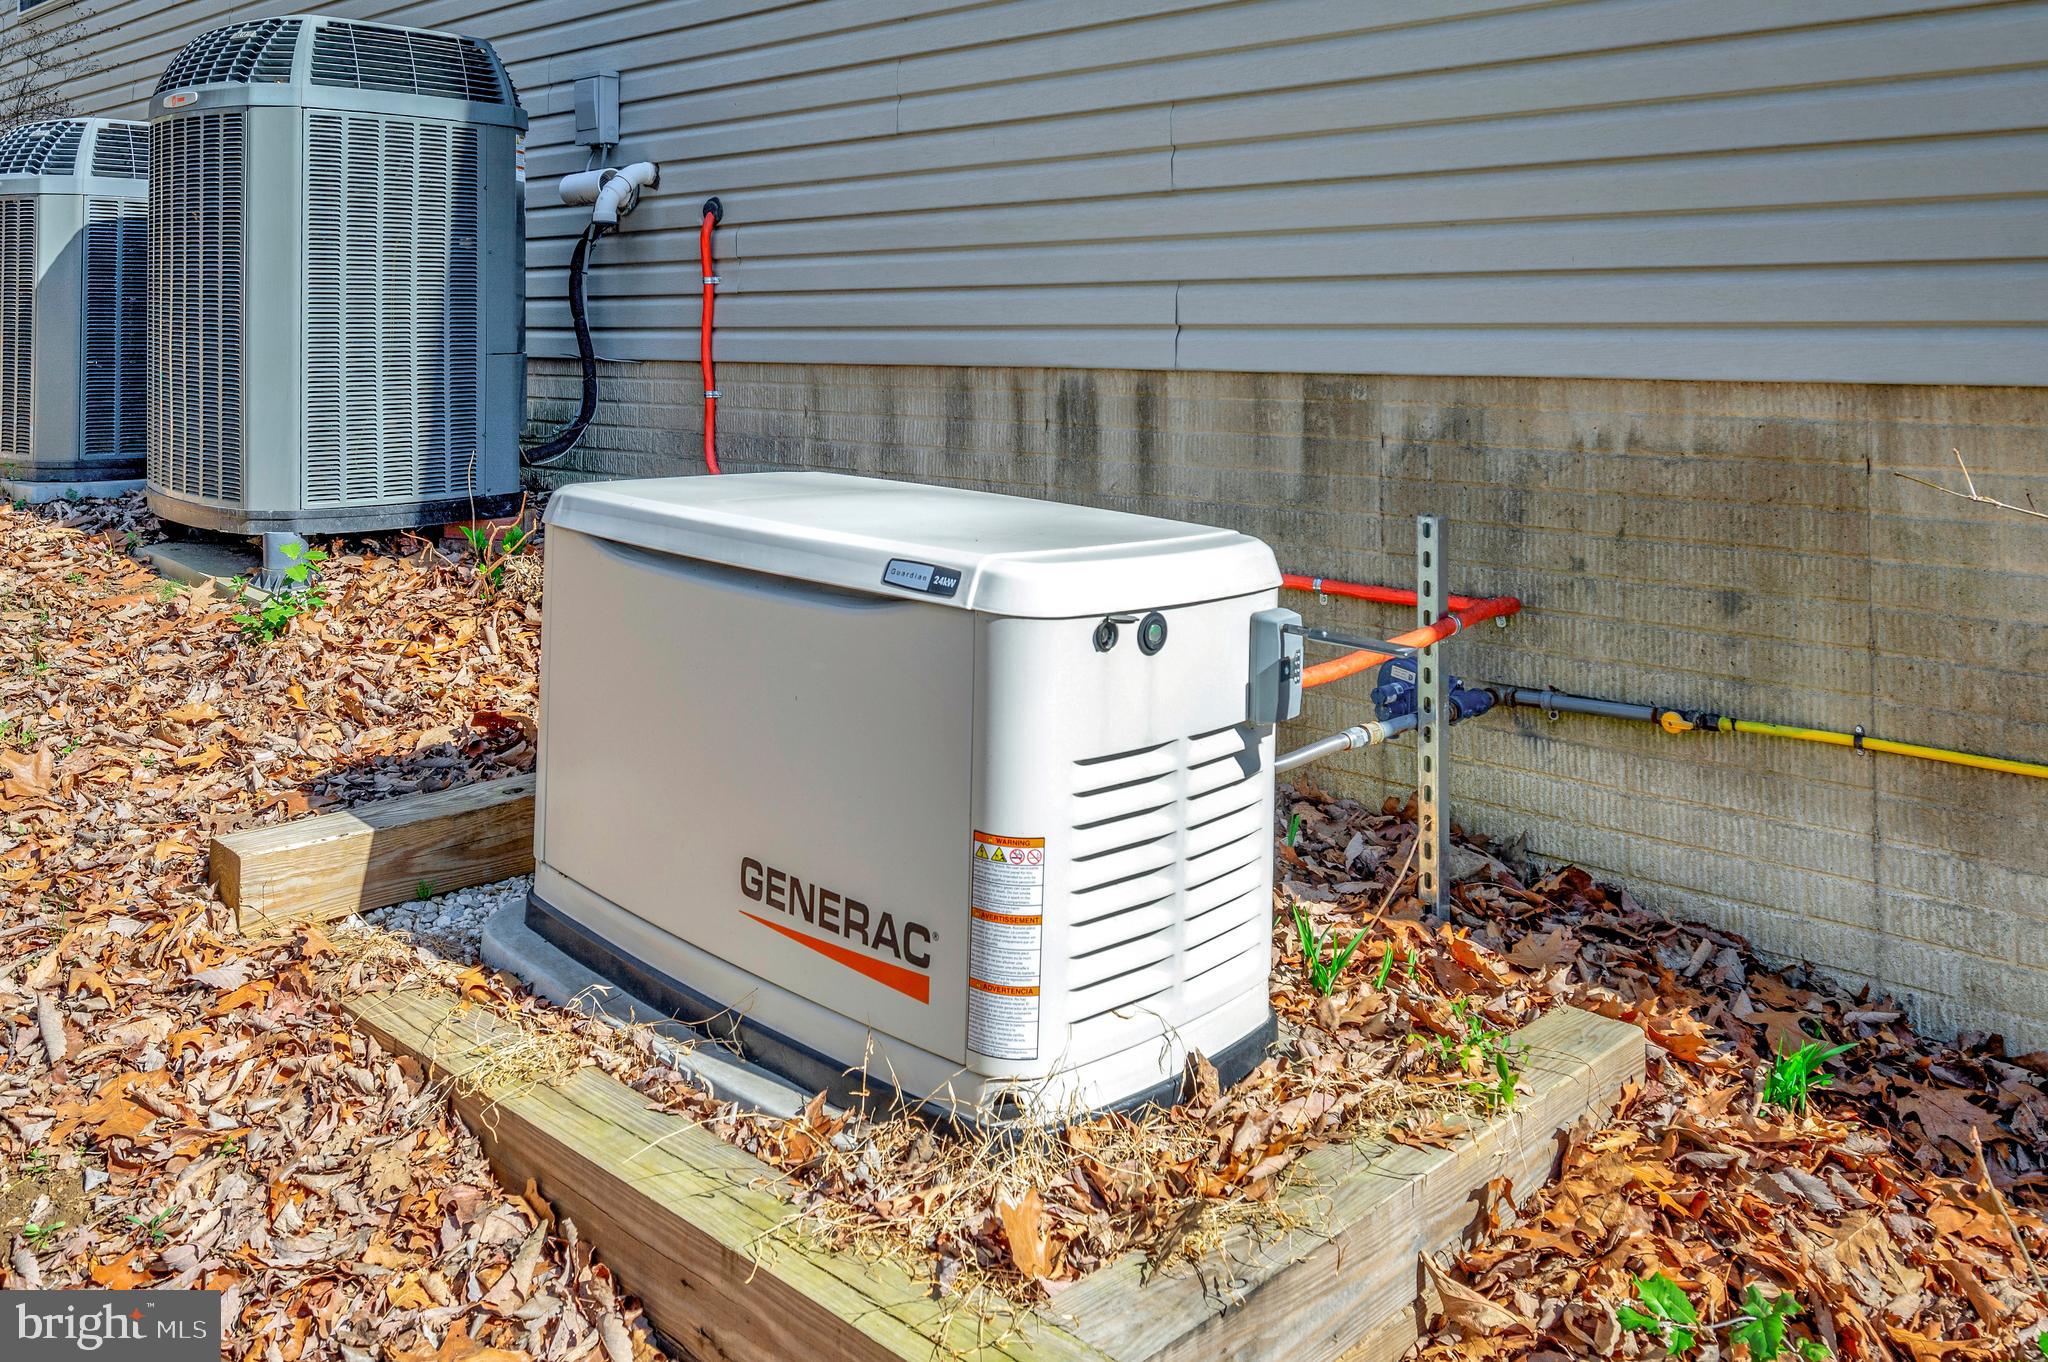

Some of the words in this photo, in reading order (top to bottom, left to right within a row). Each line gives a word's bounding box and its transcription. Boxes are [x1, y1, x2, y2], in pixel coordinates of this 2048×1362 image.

[890, 568, 927, 581] Guardian
[933, 575, 957, 588] 24kW
[995, 838, 1031, 847] WARNING
[740, 856, 931, 969] GENERAC
[981, 911, 1039, 923] AVERTISSEMENT
[982, 983, 1034, 995] ADVERTENCIA
